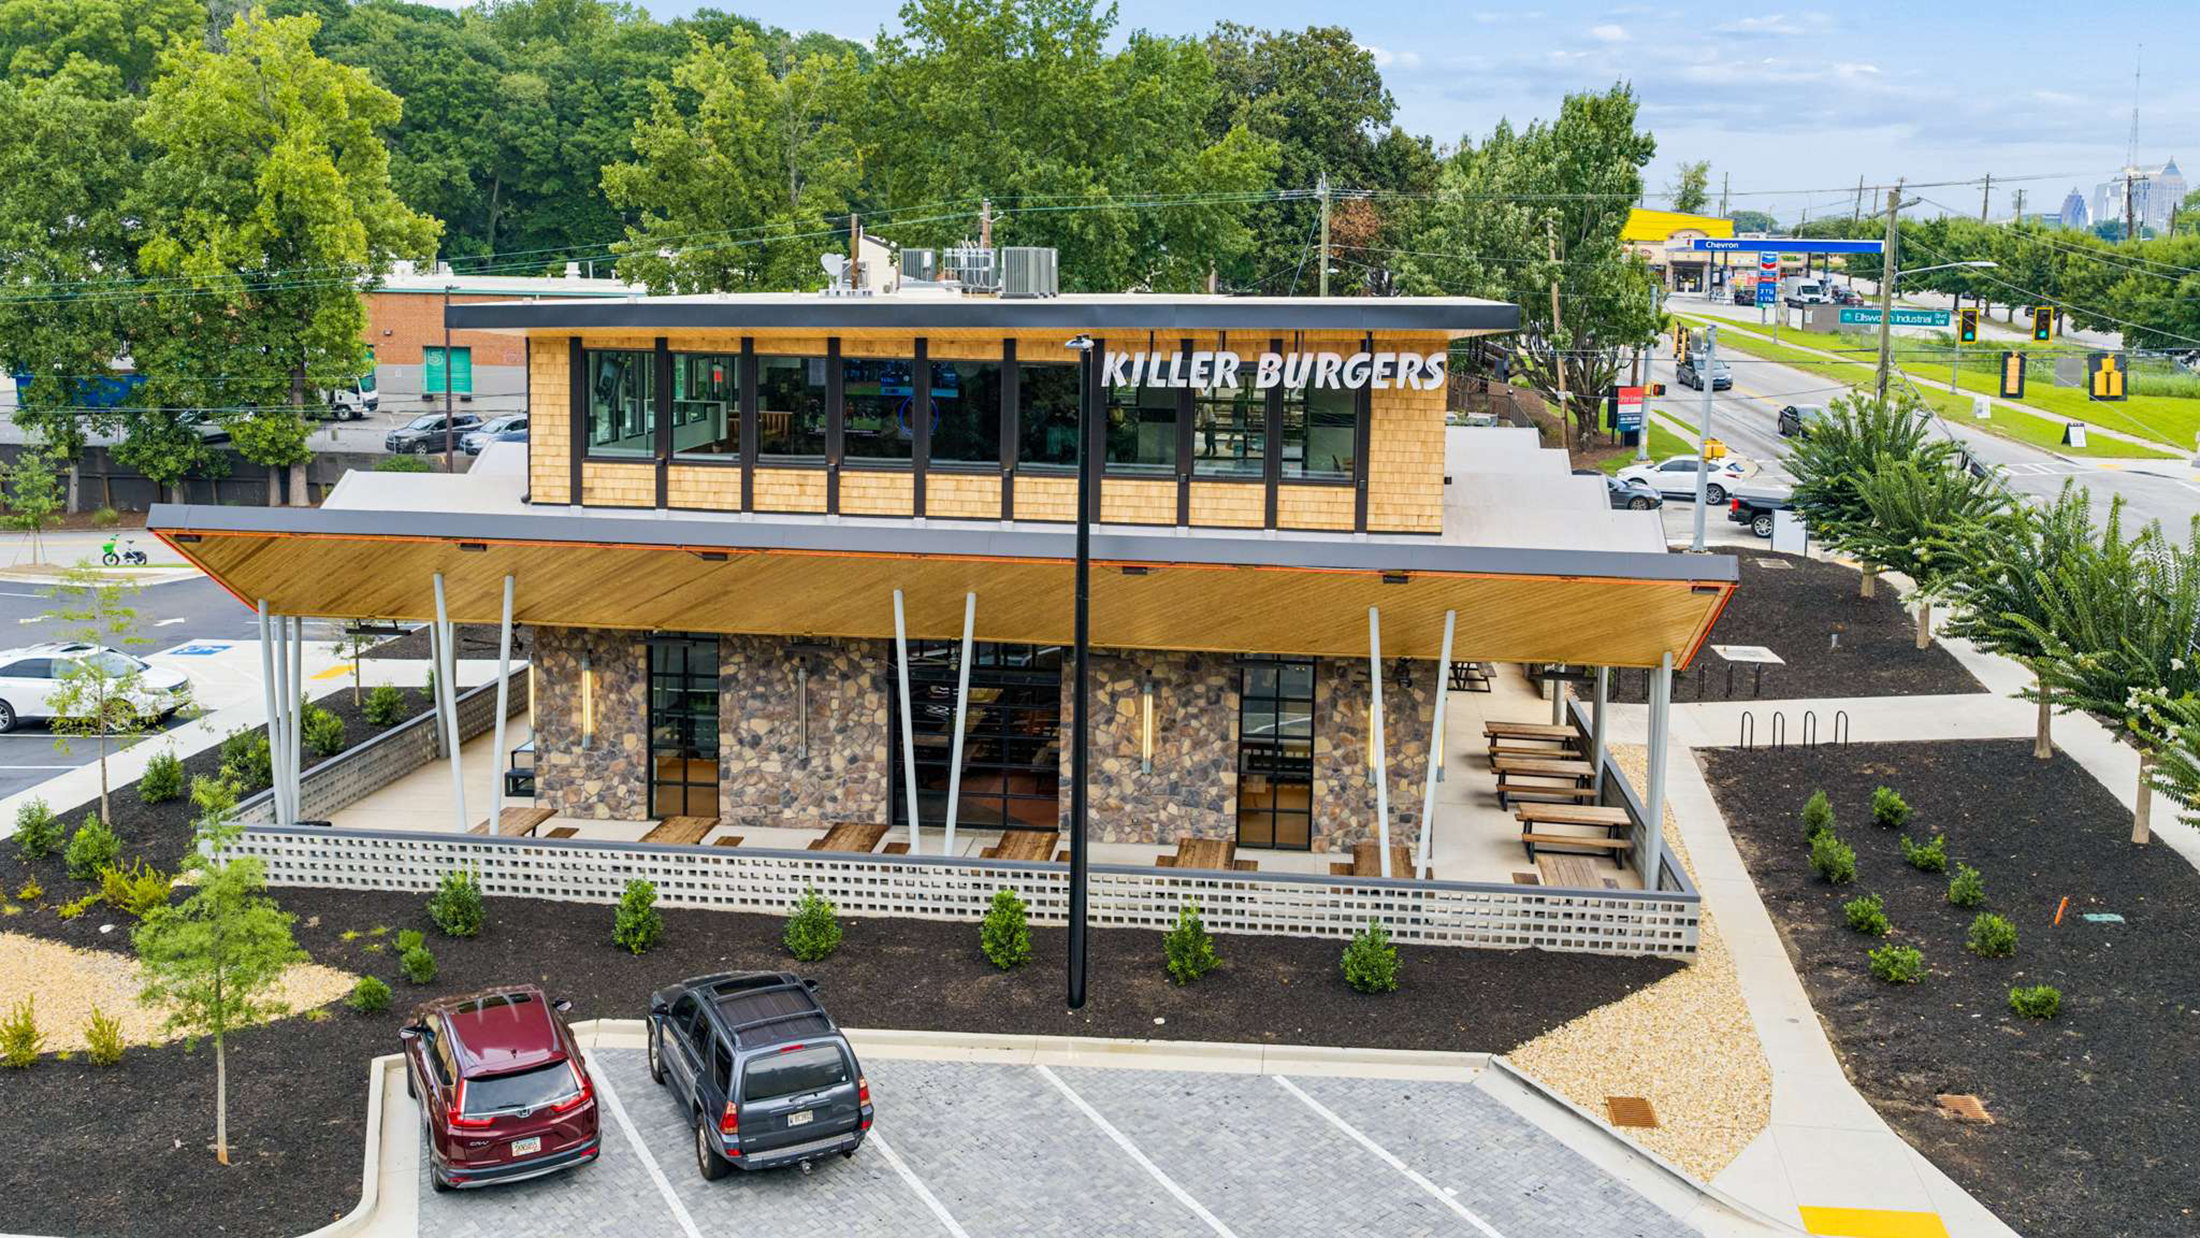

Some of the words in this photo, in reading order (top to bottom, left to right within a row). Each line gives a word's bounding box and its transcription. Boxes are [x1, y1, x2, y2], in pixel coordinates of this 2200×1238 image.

[1705, 241, 1739, 249] Chevron
[1896, 313, 1932, 324] Industrial
[427, 350, 444, 367] 5
[1101, 351, 1240, 389] KILLER
[1255, 352, 1447, 390] BURGERS
